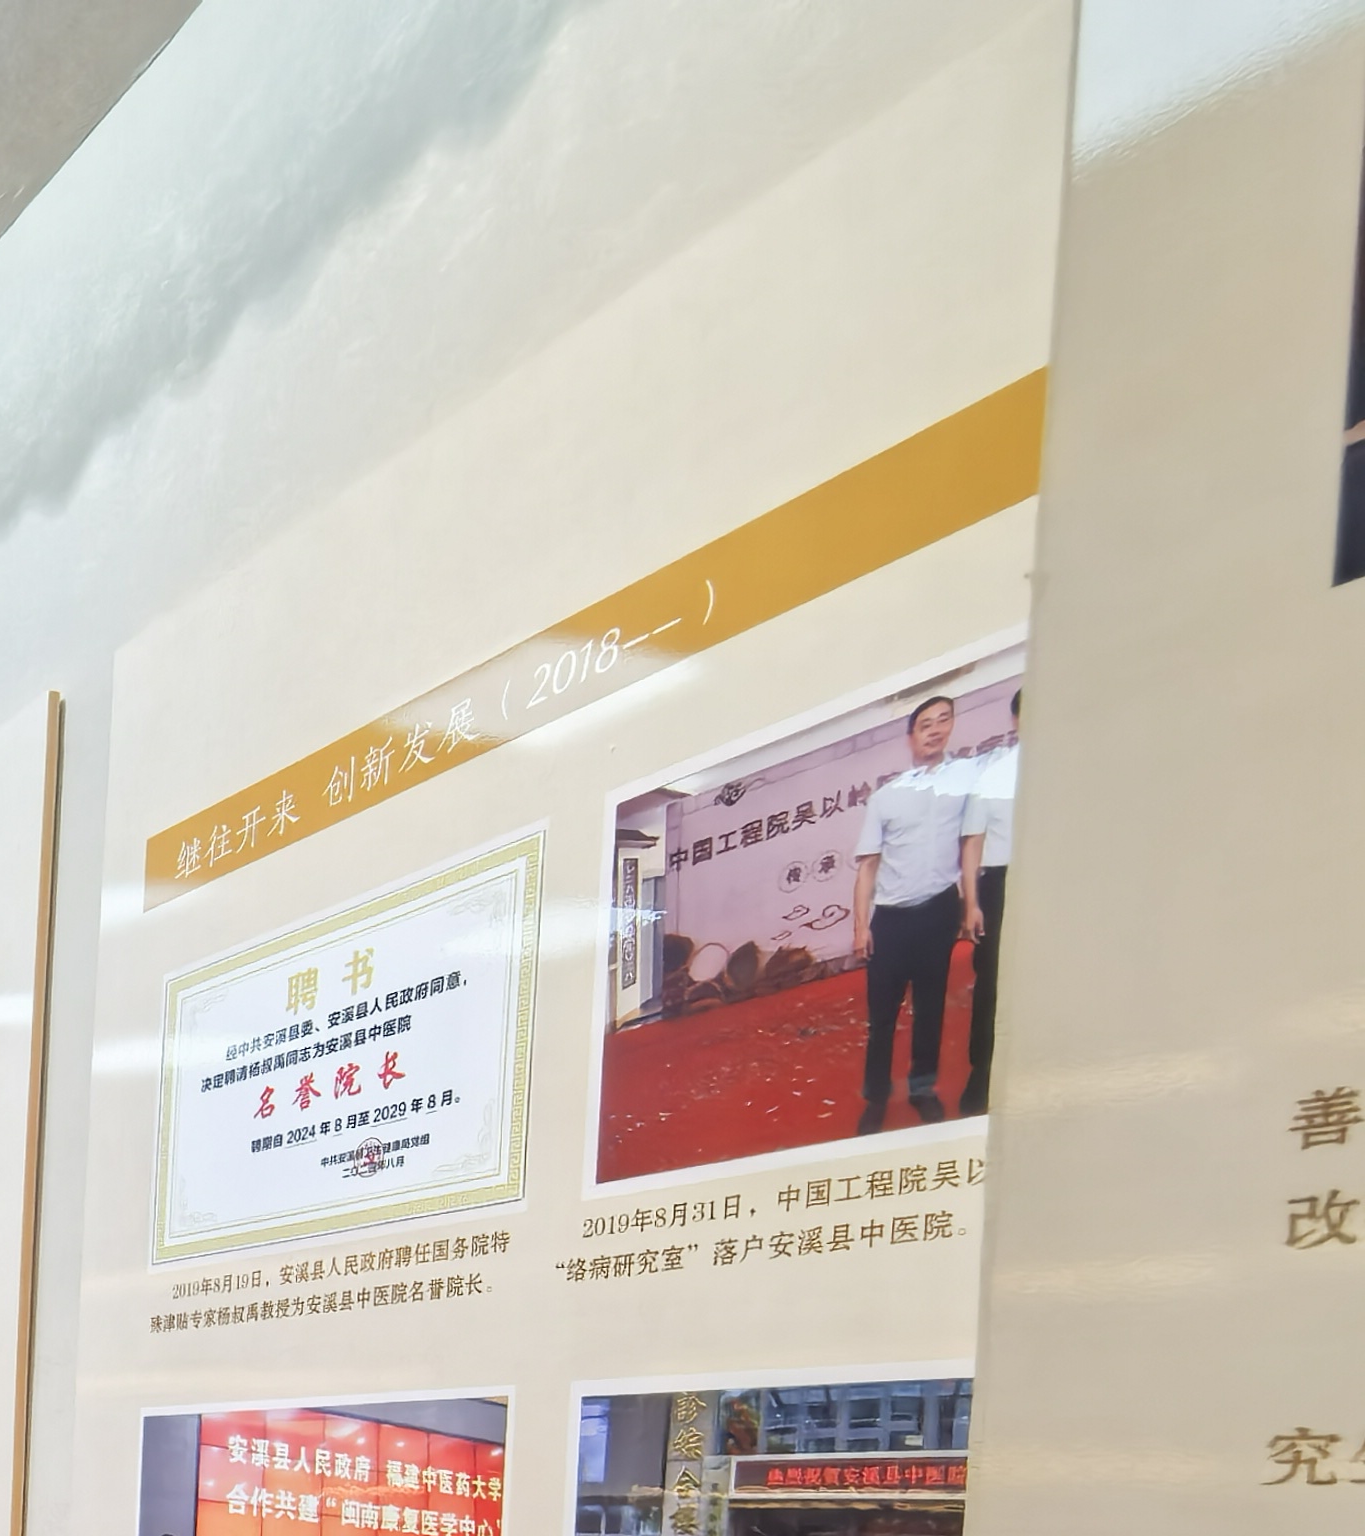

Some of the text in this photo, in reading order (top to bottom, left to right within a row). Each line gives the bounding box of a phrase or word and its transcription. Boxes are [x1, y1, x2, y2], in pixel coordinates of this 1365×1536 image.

[174, 788, 300, 880] 继往开来
[286, 947, 375, 1016] 聘书
[253, 1051, 407, 1120] 名誉院长
[1283, 1188, 1362, 1251] 改
[226, 1433, 502, 1503] 安溪县人民政府 福建中医药大学
